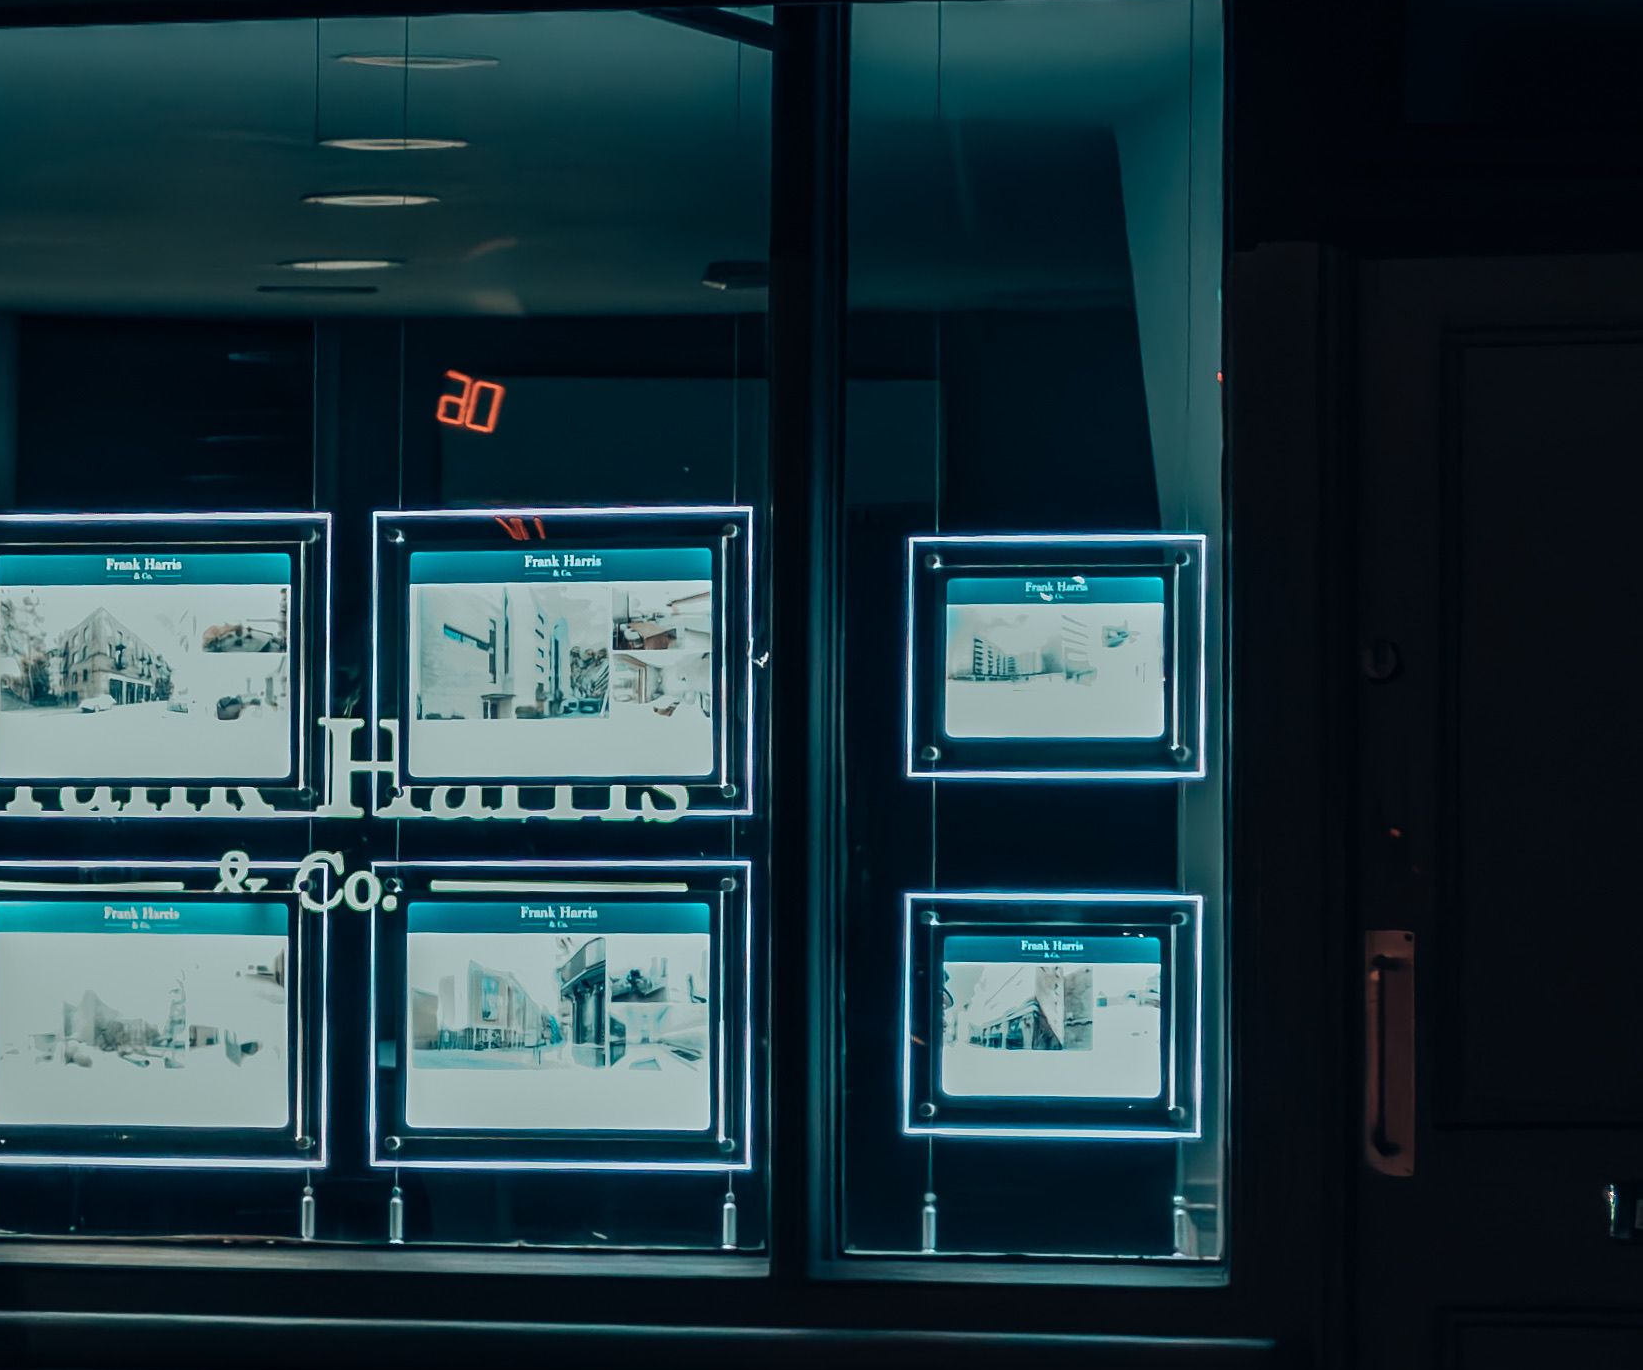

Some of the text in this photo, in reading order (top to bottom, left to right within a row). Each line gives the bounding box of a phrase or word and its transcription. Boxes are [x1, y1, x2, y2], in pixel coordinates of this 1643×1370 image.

[106, 557, 182, 571] Frank Harris
[524, 553, 602, 567] Frank Harris
[294, 850, 398, 912] Co.
[520, 905, 599, 919] Frank Harris
[1021, 939, 1084, 951] Frank Harris
